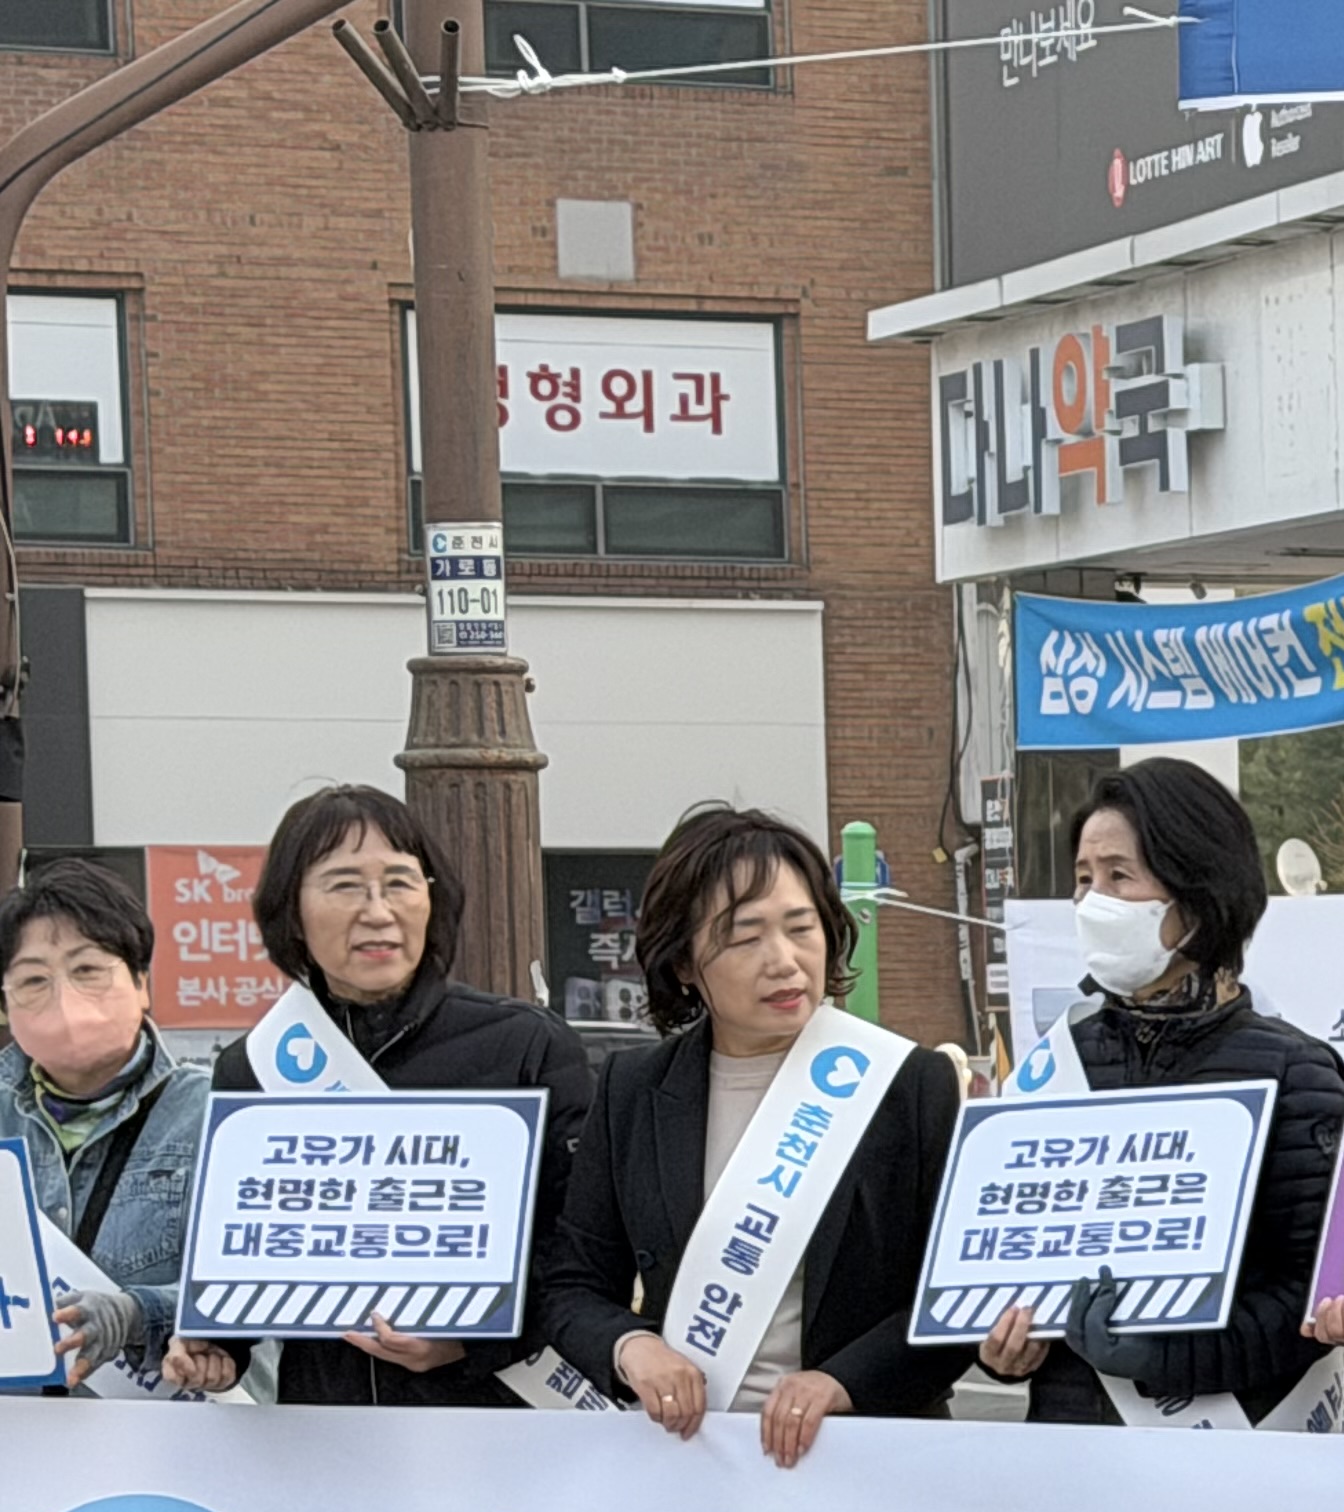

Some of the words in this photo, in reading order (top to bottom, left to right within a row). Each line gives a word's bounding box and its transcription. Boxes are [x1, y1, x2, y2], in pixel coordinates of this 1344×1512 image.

[1129, 151, 1169, 185] LOTTE
[495, 363, 731, 435] 형외과
[938, 316, 1172, 526] 다나약국
[437, 587, 499, 615] 110-01
[1039, 629, 1106, 715] 삼성
[1106, 626, 1215, 712] 시스템
[1195, 608, 1322, 704] 에어컨
[174, 878, 212, 904] SK
[569, 888, 641, 929] 갤럭
[176, 976, 228, 1006] 본사
[262, 1134, 376, 1166] 고유가
[384, 1134, 470, 1168] 시대,
[757, 1101, 835, 1199] 춘천시
[1003, 1135, 1110, 1170] 고유가
[1115, 1129, 1197, 1164] 시대,
[236, 1177, 358, 1212] 현명한
[367, 1177, 487, 1212] 출근은
[976, 1178, 1090, 1216] 현명한
[1095, 1171, 1208, 1210] 출근은
[221, 1222, 490, 1259] 대중교통으로!
[720, 1202, 780, 1276] 교통
[958, 1215, 1208, 1262] 대중교통으로!
[685, 1282, 744, 1357] 안전
